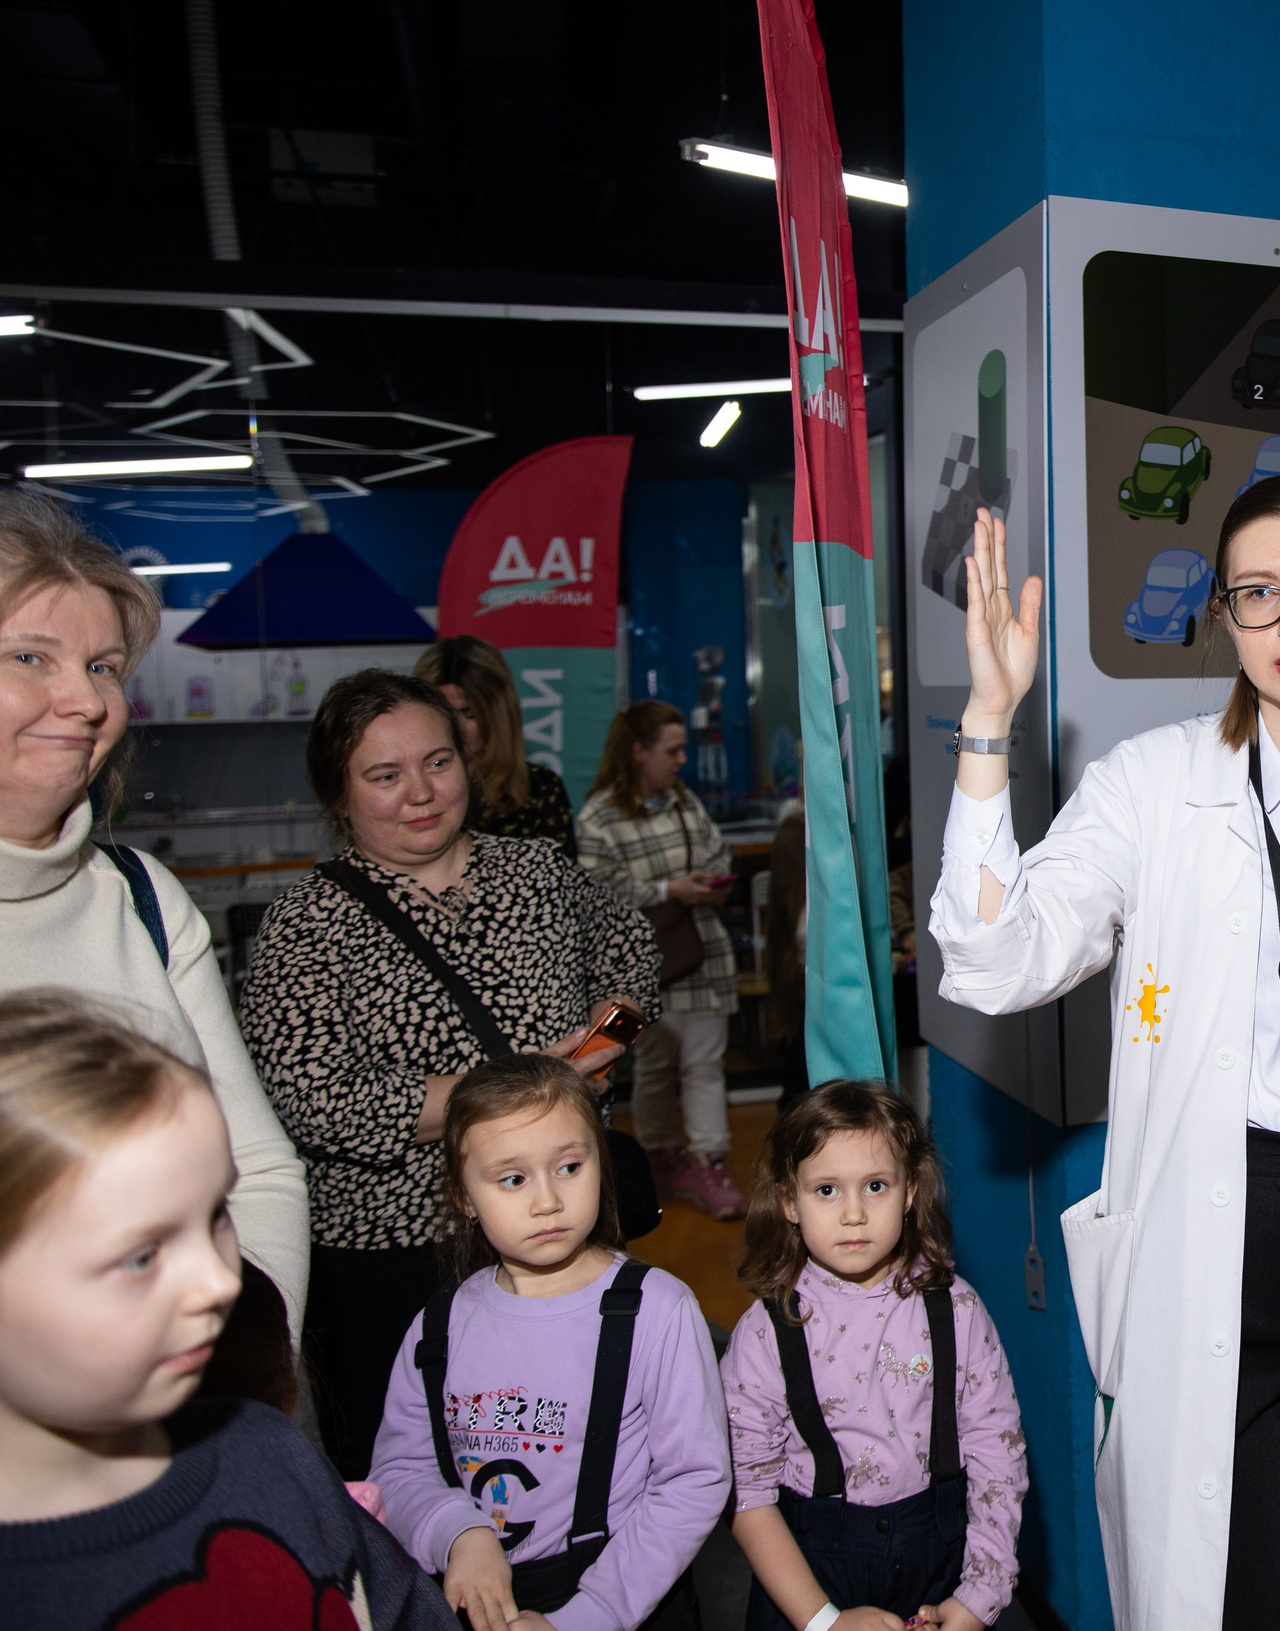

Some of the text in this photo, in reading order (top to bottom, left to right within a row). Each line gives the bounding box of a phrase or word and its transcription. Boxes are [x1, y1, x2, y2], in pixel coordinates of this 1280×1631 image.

[1253, 384, 1264, 400] 2
[489, 535, 595, 583] ДА!
[484, 1436, 519, 1452] H365
